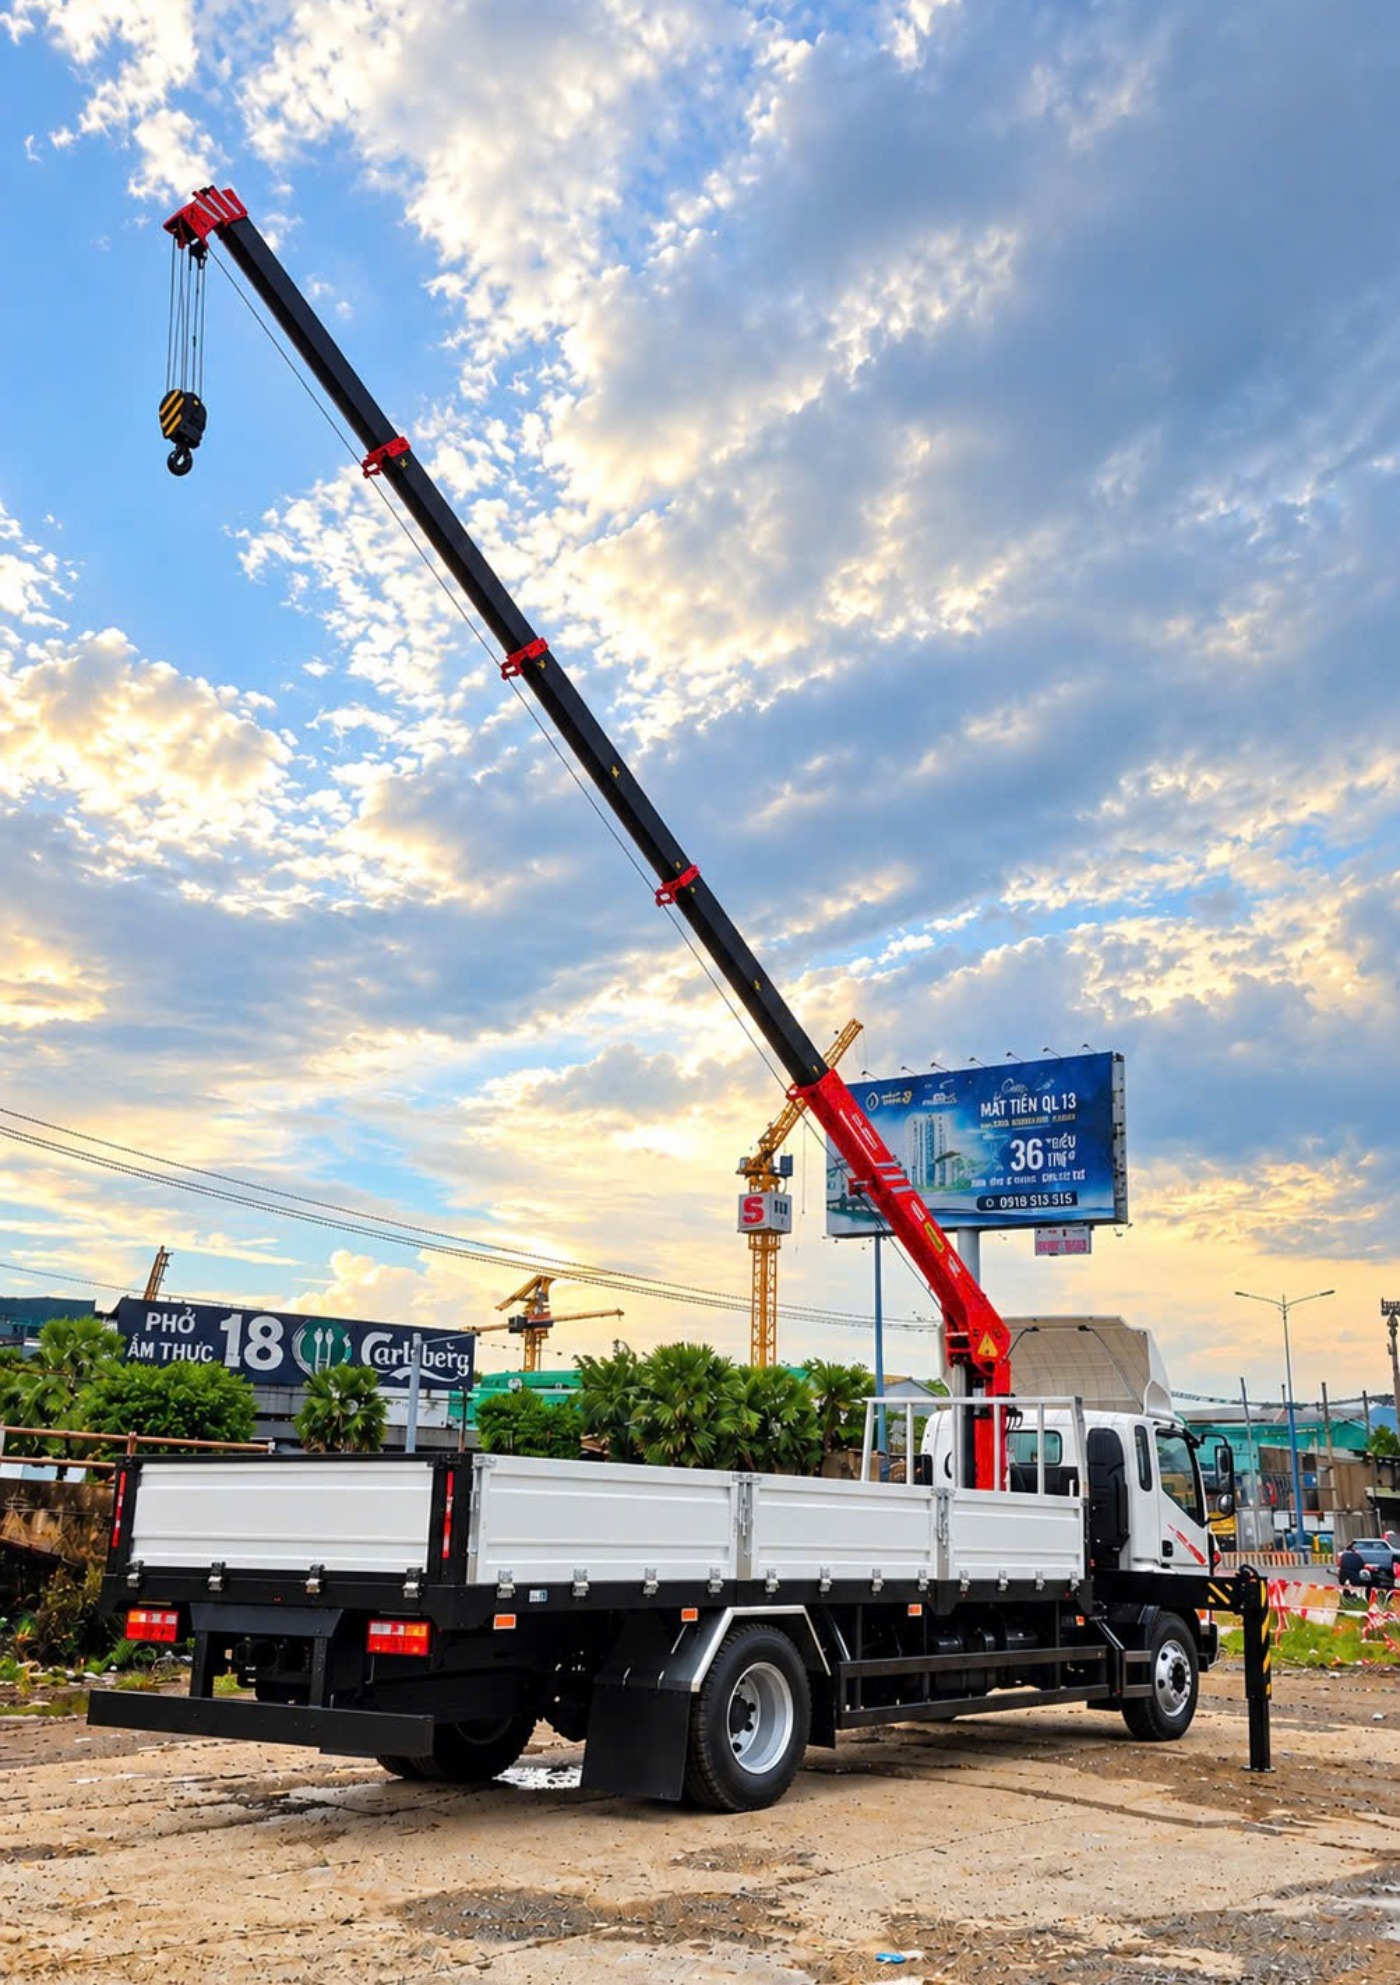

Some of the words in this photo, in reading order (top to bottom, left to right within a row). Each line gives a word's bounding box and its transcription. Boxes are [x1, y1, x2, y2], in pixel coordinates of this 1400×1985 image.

[1061, 1092, 1077, 1110] 13
[1010, 1137, 1044, 1172] 36
[742, 1195, 765, 1225] S
[145, 1306, 197, 1334] PHỞ
[219, 1313, 284, 1371] 18
[361, 1331, 470, 1377] Carlberg
